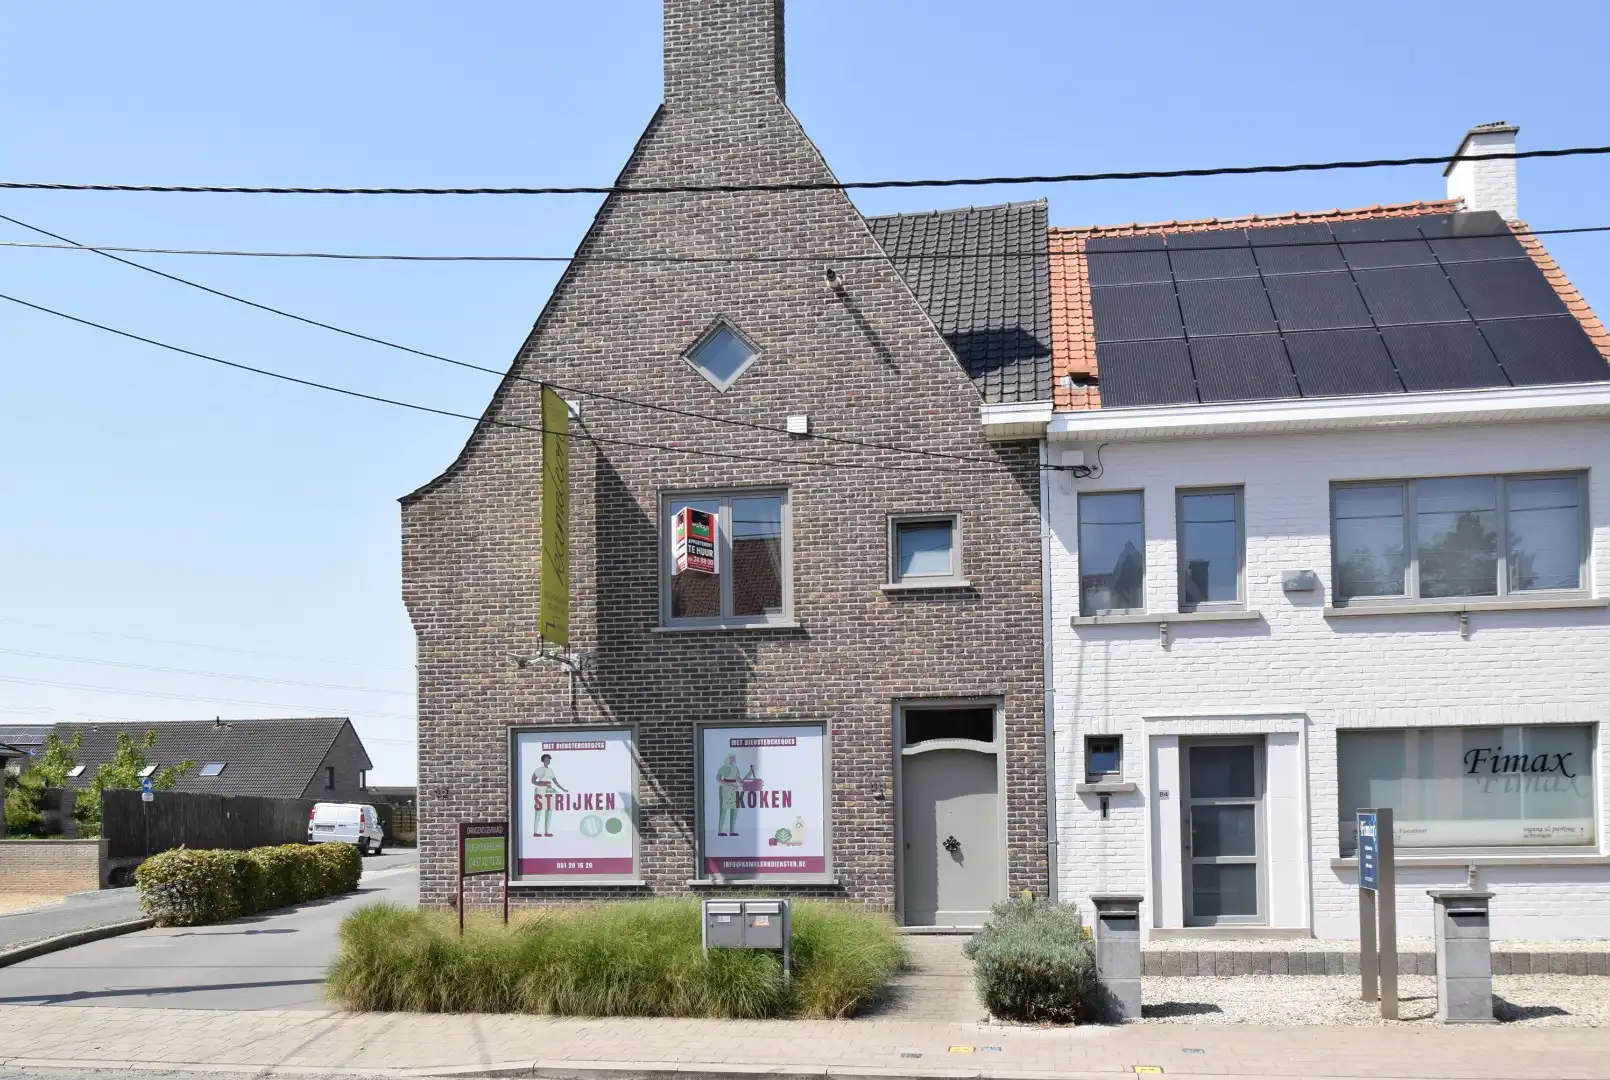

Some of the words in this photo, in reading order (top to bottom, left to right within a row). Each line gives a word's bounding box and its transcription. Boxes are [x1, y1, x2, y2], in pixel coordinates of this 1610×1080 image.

[688, 545, 695, 554] TE
[696, 546, 714, 557] HUUR
[1464, 746, 1576, 779] Fimax
[534, 792, 616, 811] STRIJKEN
[735, 790, 792, 809] KOKEN
